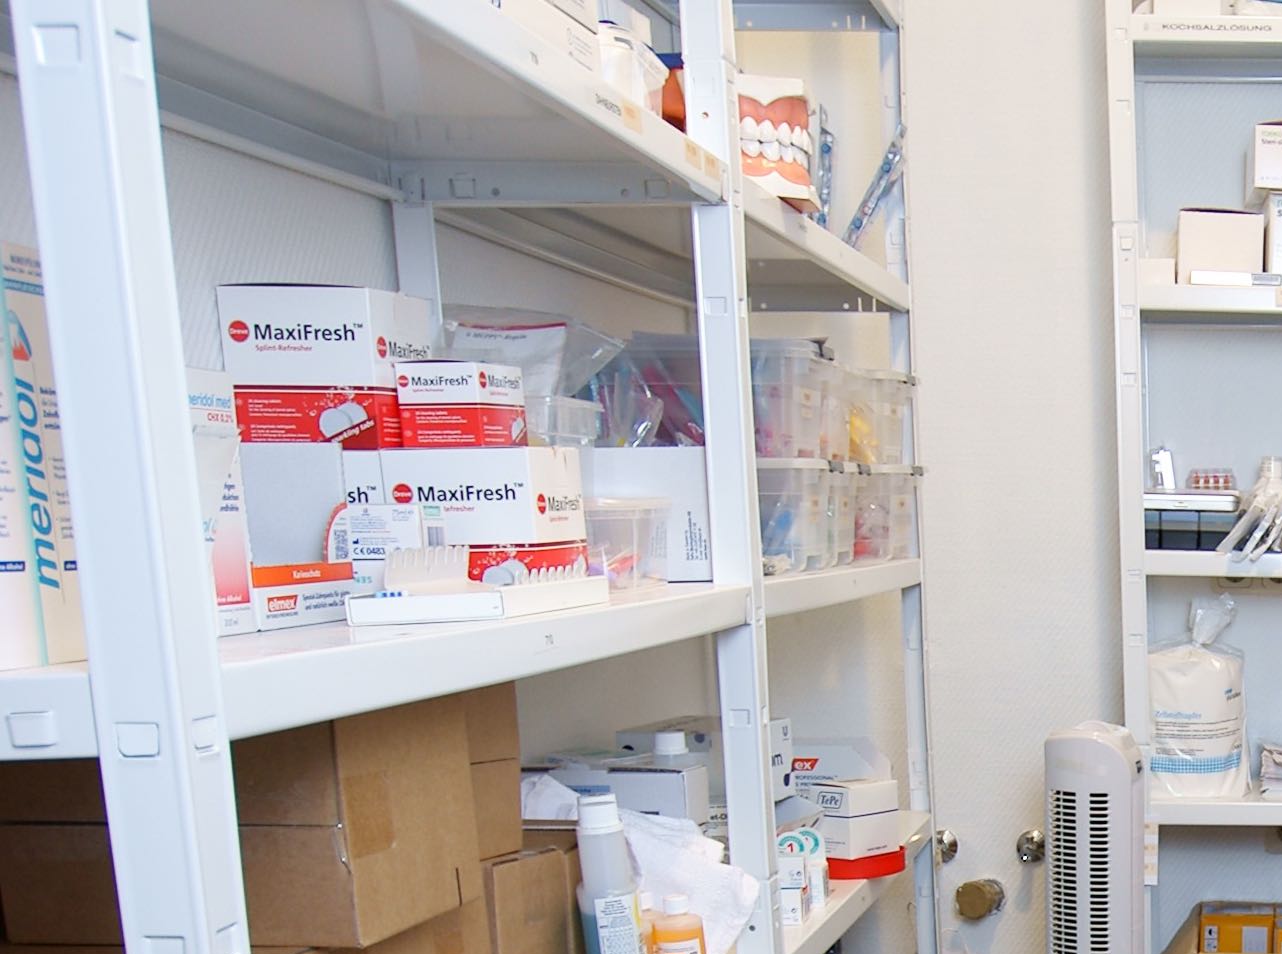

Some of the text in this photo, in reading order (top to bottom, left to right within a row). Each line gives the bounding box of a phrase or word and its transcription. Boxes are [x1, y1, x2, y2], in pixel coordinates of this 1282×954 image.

[1162, 23, 1273, 32] KOCHSALZLÖSUNG
[15, 377, 60, 590] meridol
[269, 595, 297, 612] elmex
[820, 794, 839, 807] TePe
